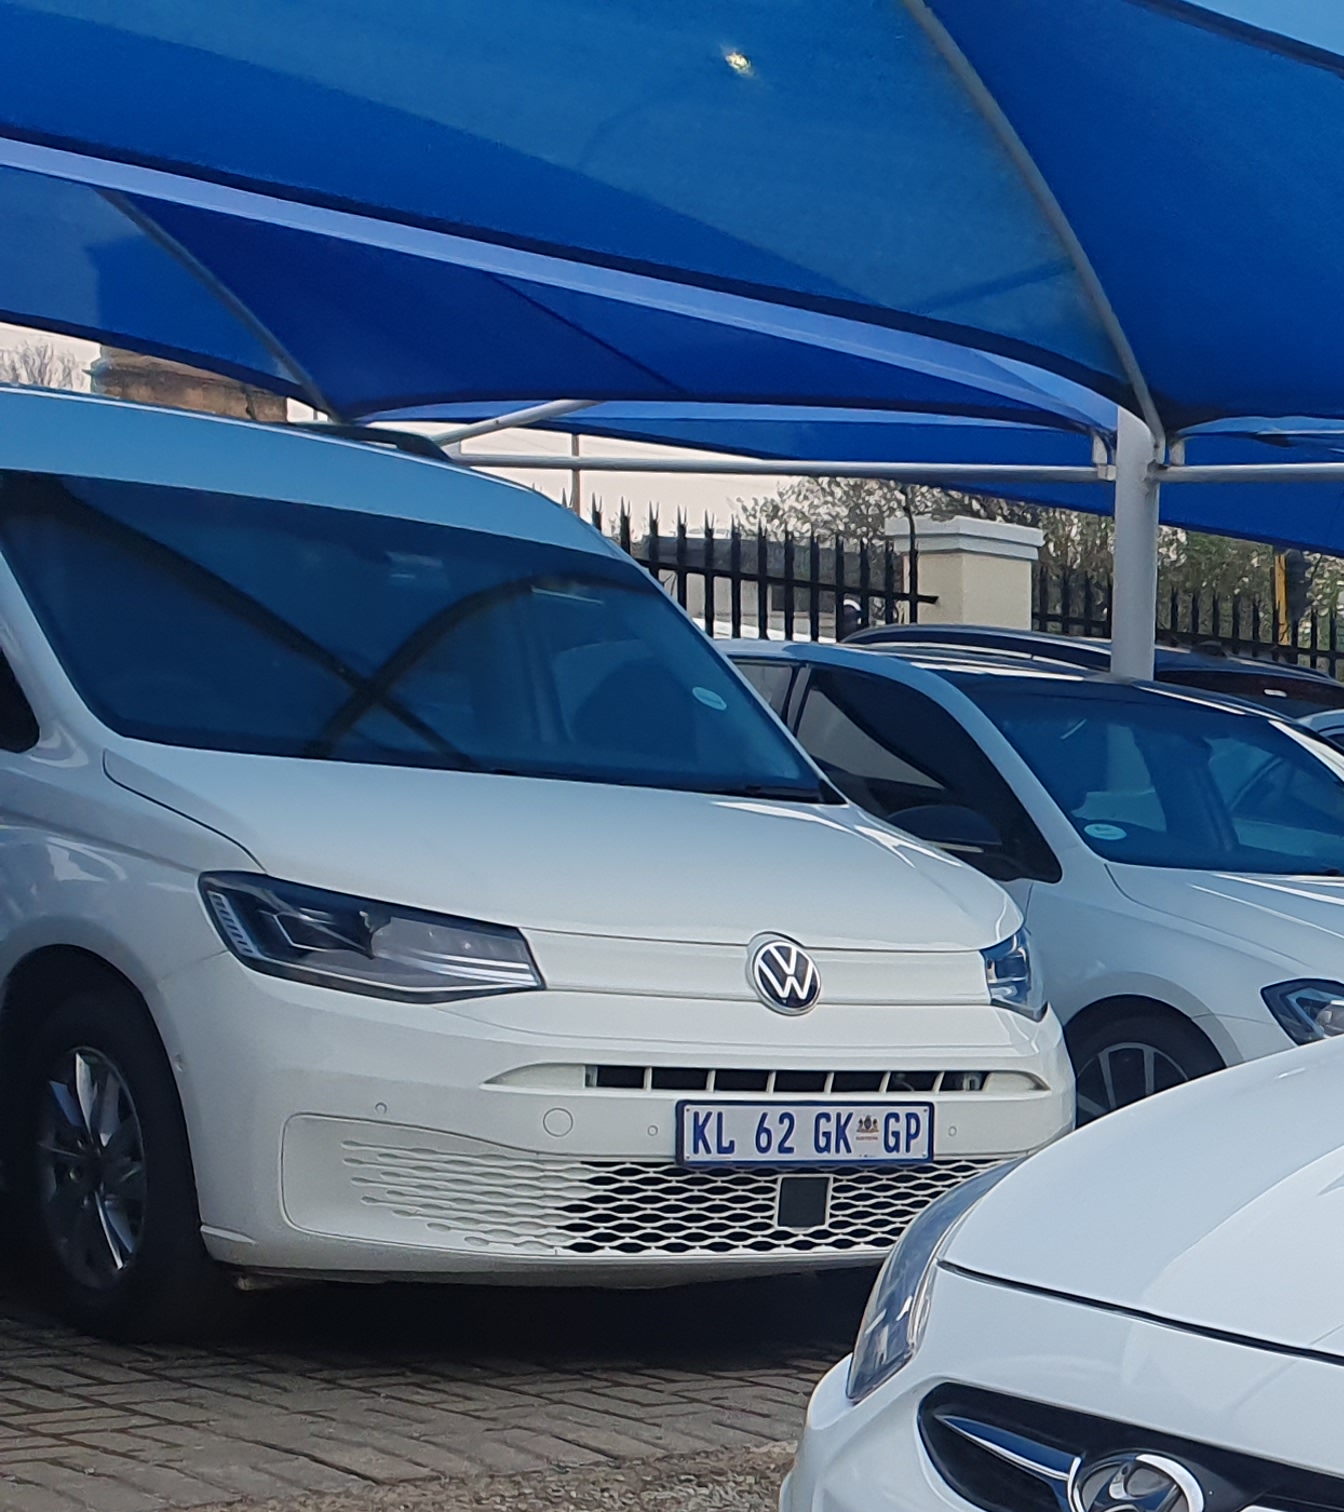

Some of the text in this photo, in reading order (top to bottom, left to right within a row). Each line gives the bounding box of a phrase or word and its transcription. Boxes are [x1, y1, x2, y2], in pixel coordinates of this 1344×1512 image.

[692, 1110, 922, 1155] KL 62 GK GP
